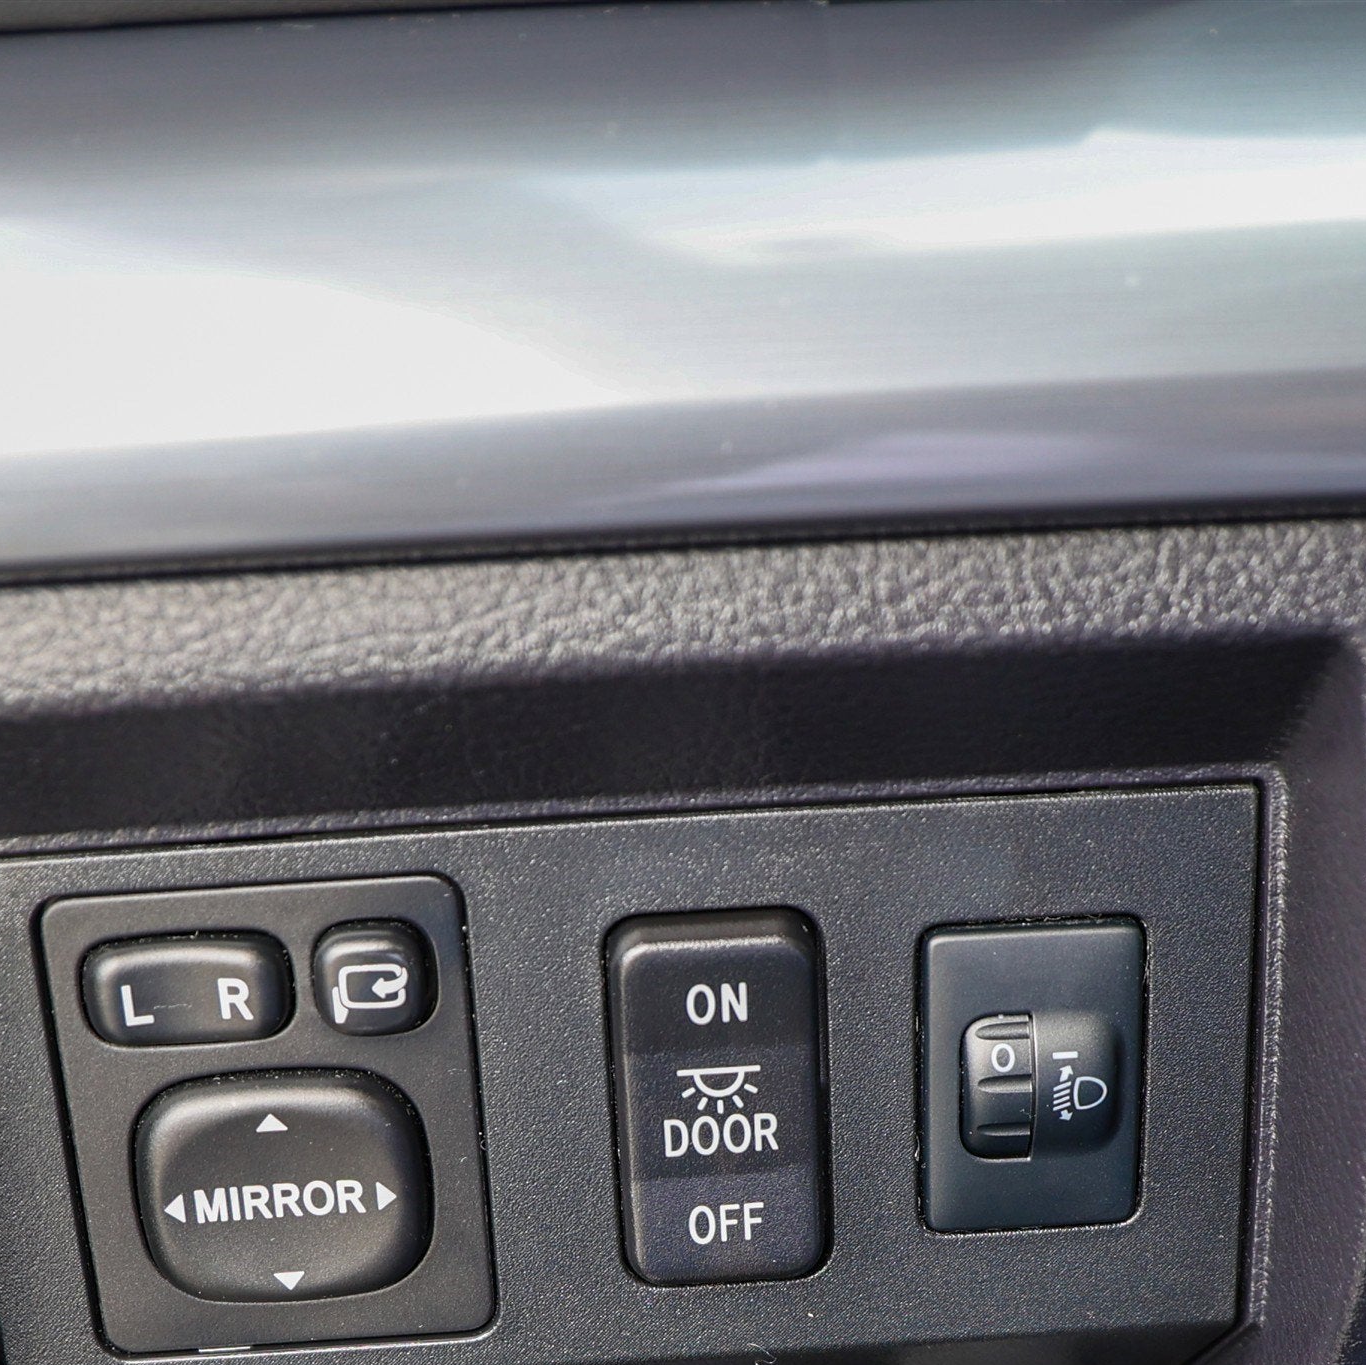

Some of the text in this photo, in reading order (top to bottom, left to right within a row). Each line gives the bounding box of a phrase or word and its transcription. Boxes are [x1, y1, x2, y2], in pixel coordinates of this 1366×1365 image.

[120, 977, 254, 1027] L R
[685, 981, 749, 1025] ON
[663, 1111, 779, 1158] DOOR
[193, 1178, 367, 1225] MIRROR
[688, 1201, 765, 1247] OFF
